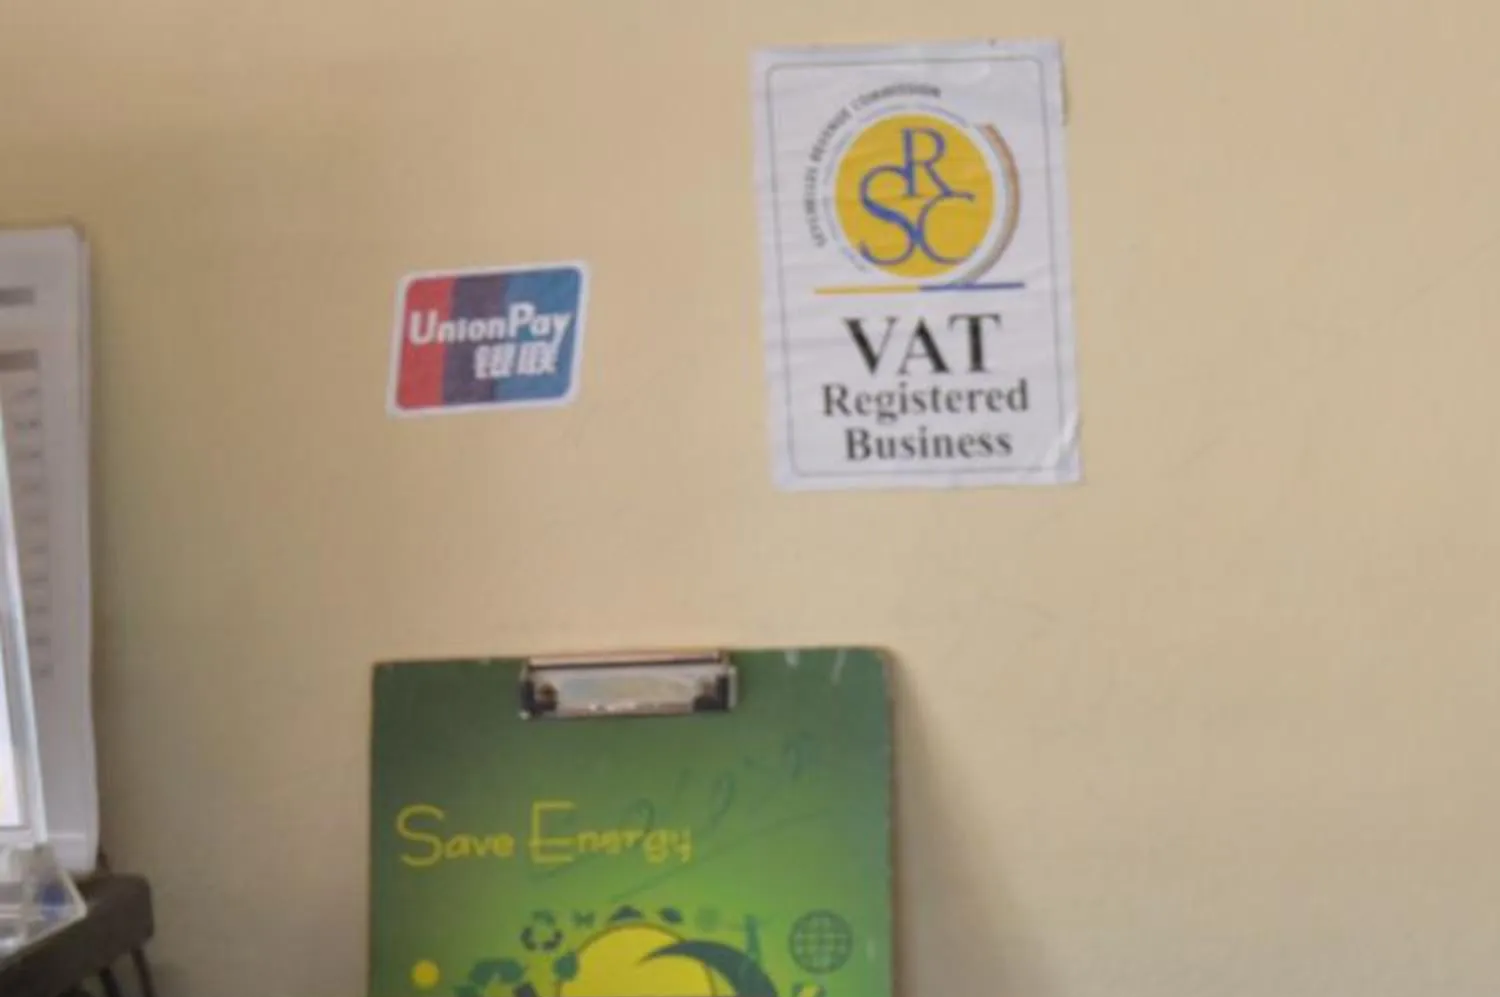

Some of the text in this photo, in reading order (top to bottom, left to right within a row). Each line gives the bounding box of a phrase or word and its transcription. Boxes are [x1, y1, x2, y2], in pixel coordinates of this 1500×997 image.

[409, 302, 574, 355] UnionPay
[843, 312, 1002, 378] VAT
[821, 376, 1029, 424] Registered
[844, 425, 1013, 462] Business
[396, 803, 514, 868] Save
[529, 799, 692, 866] Energy
